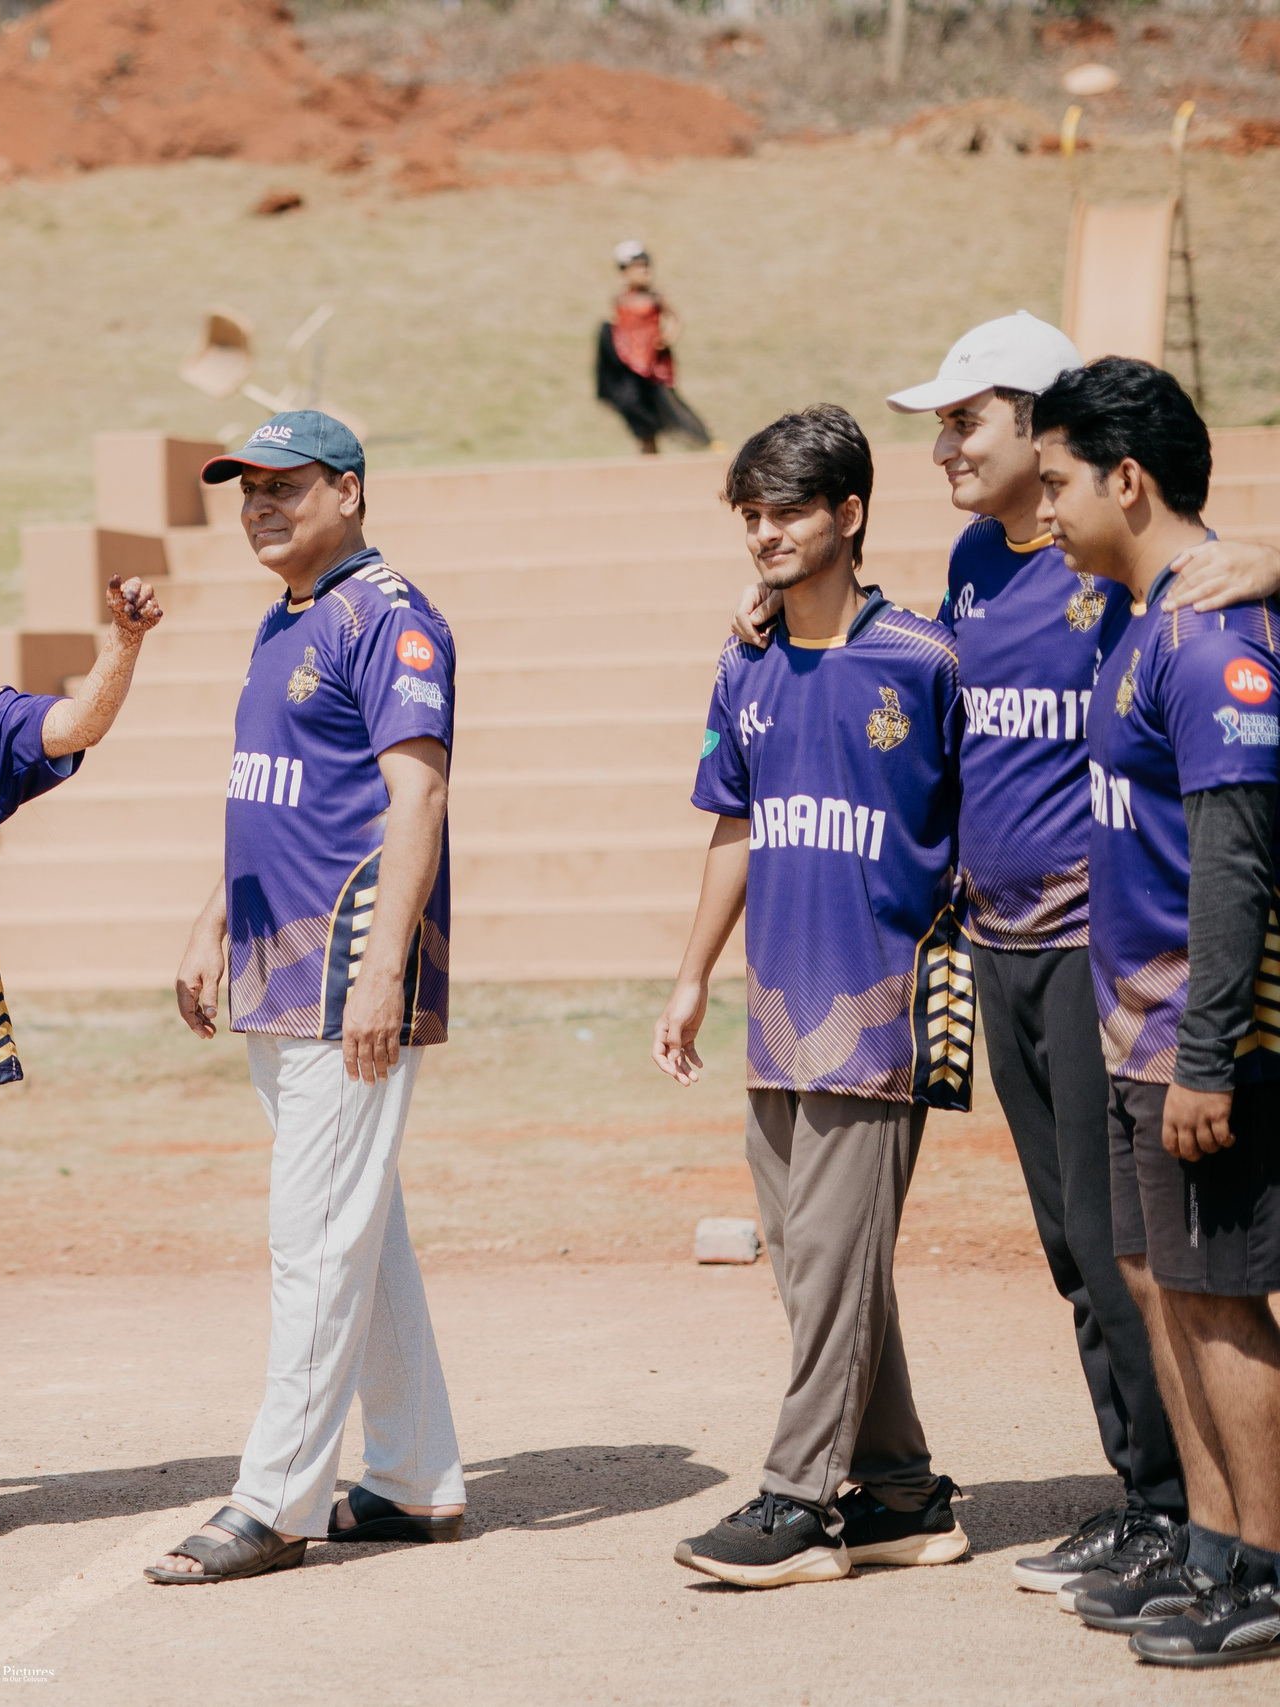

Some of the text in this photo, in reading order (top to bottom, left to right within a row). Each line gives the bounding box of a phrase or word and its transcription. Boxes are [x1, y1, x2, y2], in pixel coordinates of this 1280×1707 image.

[402, 641, 431, 660] Jio
[1231, 668, 1268, 692] Jio
[1240, 713, 1279, 726] INDIAN
